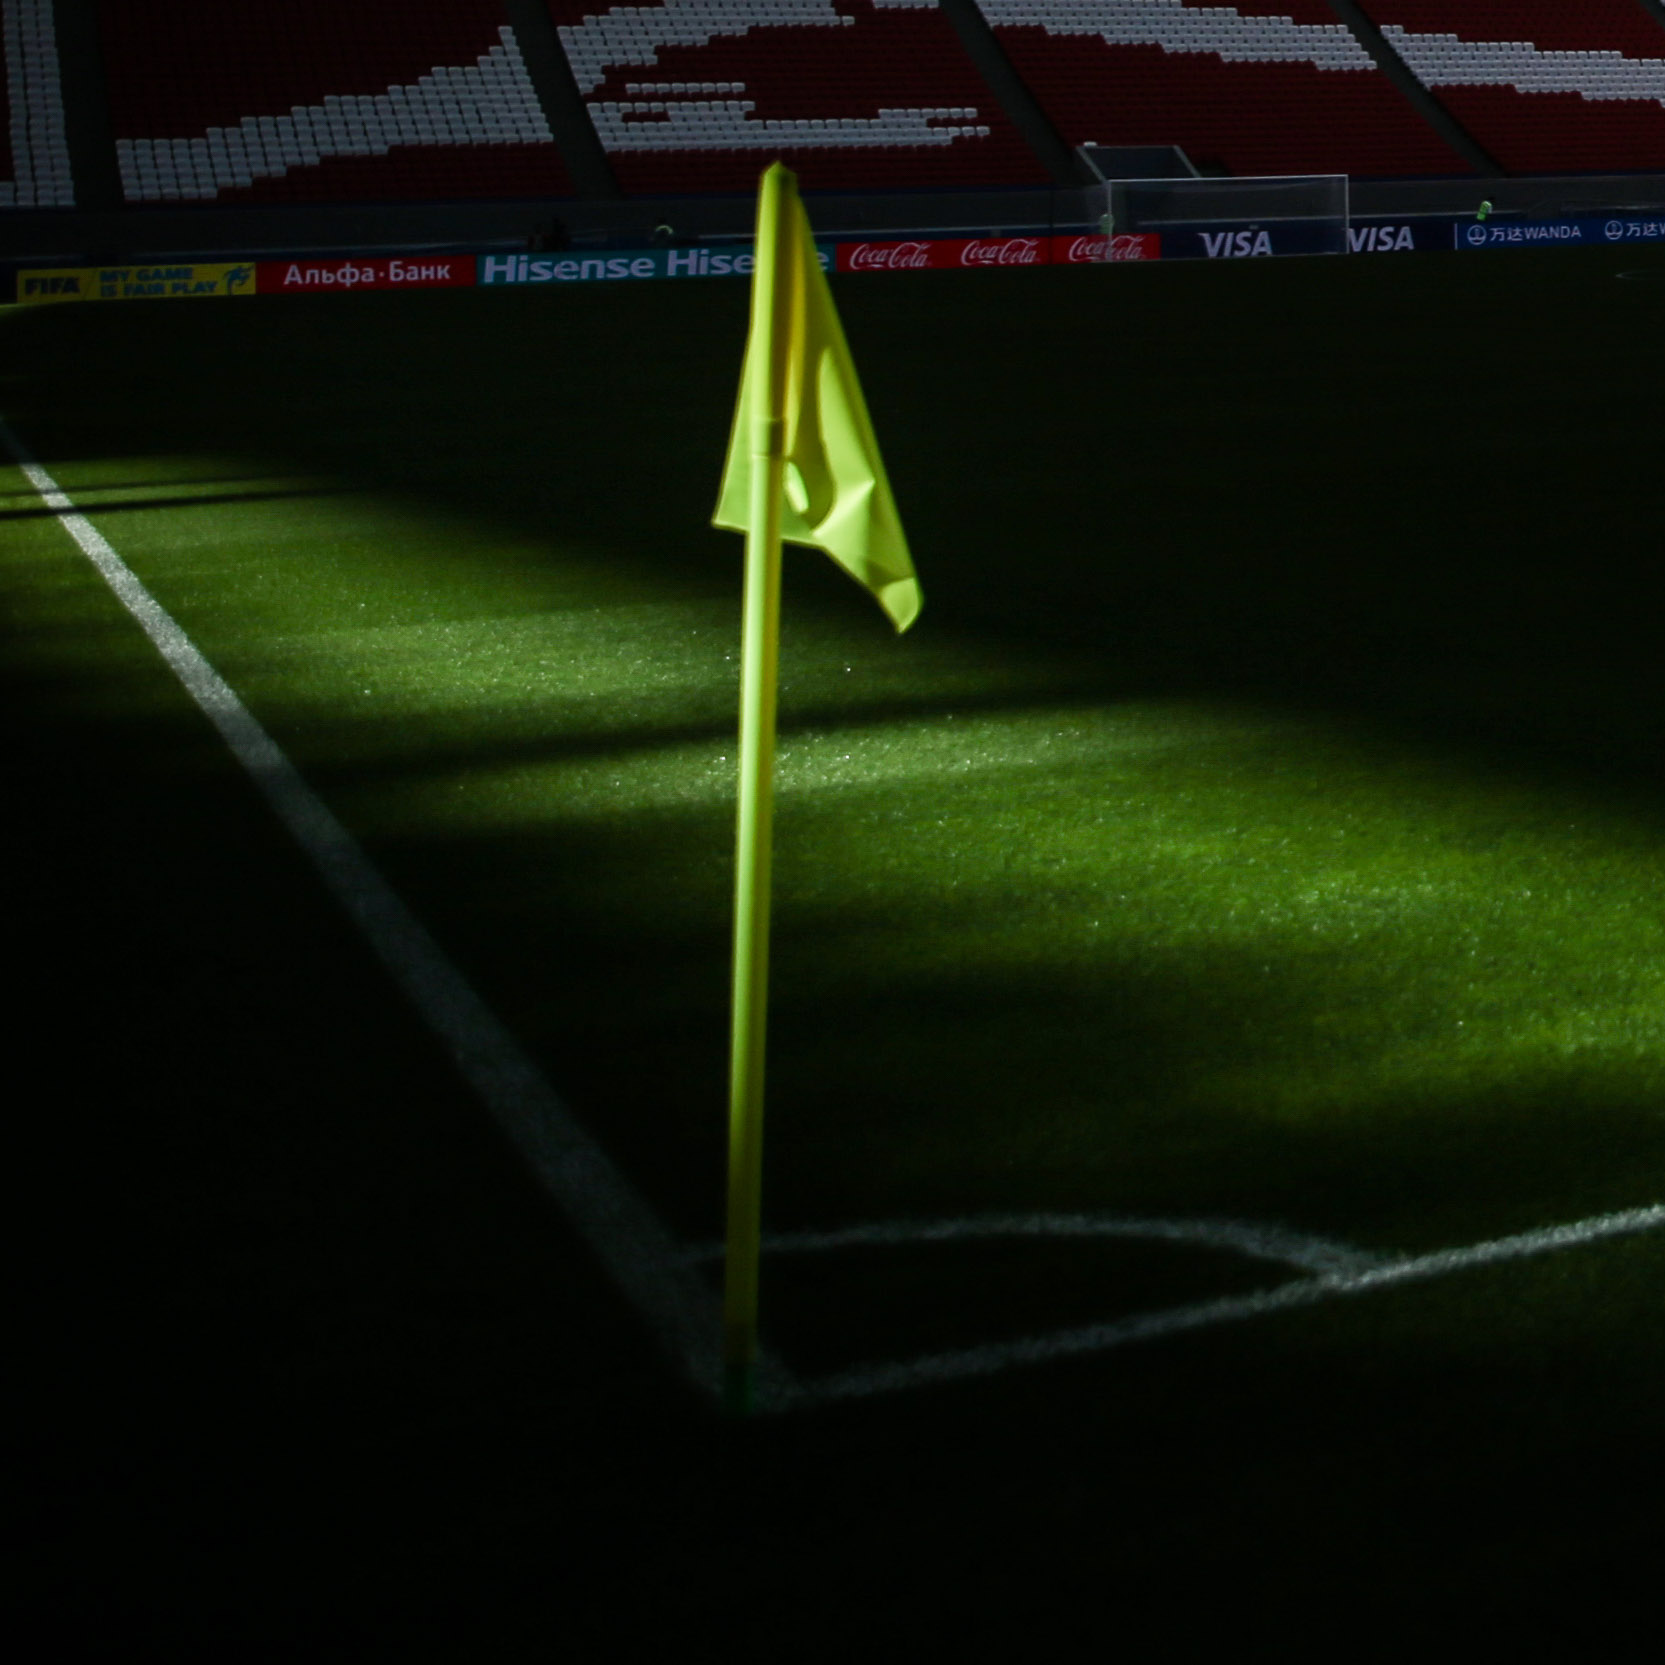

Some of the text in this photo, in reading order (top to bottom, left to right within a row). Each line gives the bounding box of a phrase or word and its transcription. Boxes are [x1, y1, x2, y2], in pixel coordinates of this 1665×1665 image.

[1198, 226, 1415, 258] VISA VISA
[137, 268, 192, 281] GAME
[483, 248, 830, 284] Hisense Hisee
[25, 277, 80, 293] FIFA
